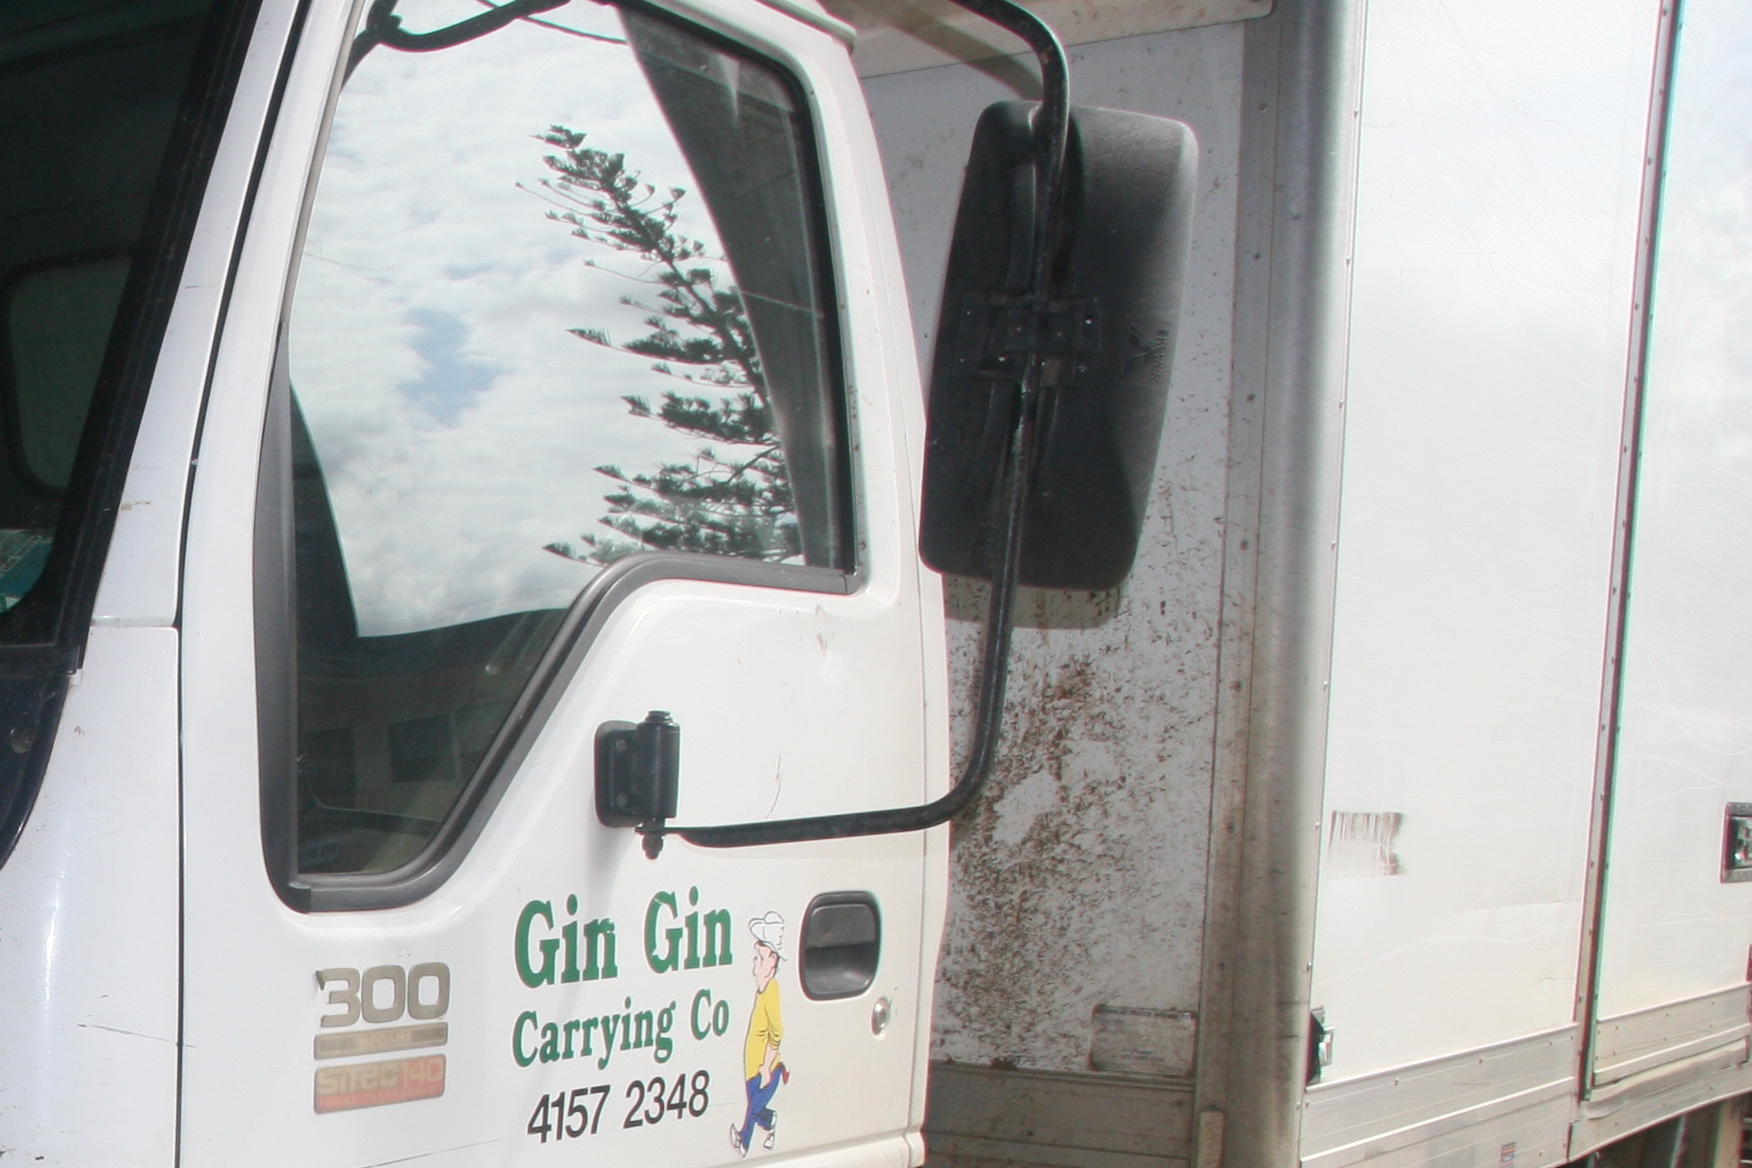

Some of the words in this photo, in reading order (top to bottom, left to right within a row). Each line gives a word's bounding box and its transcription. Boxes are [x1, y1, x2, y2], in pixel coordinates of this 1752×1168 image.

[514, 894, 618, 988] Gin
[645, 886, 733, 974] Gin
[316, 961, 450, 1028] 300
[512, 997, 676, 1069] Carrying
[690, 989, 730, 1040] Co
[527, 1085, 611, 1143] 4157
[624, 1070, 711, 1130] 2348
